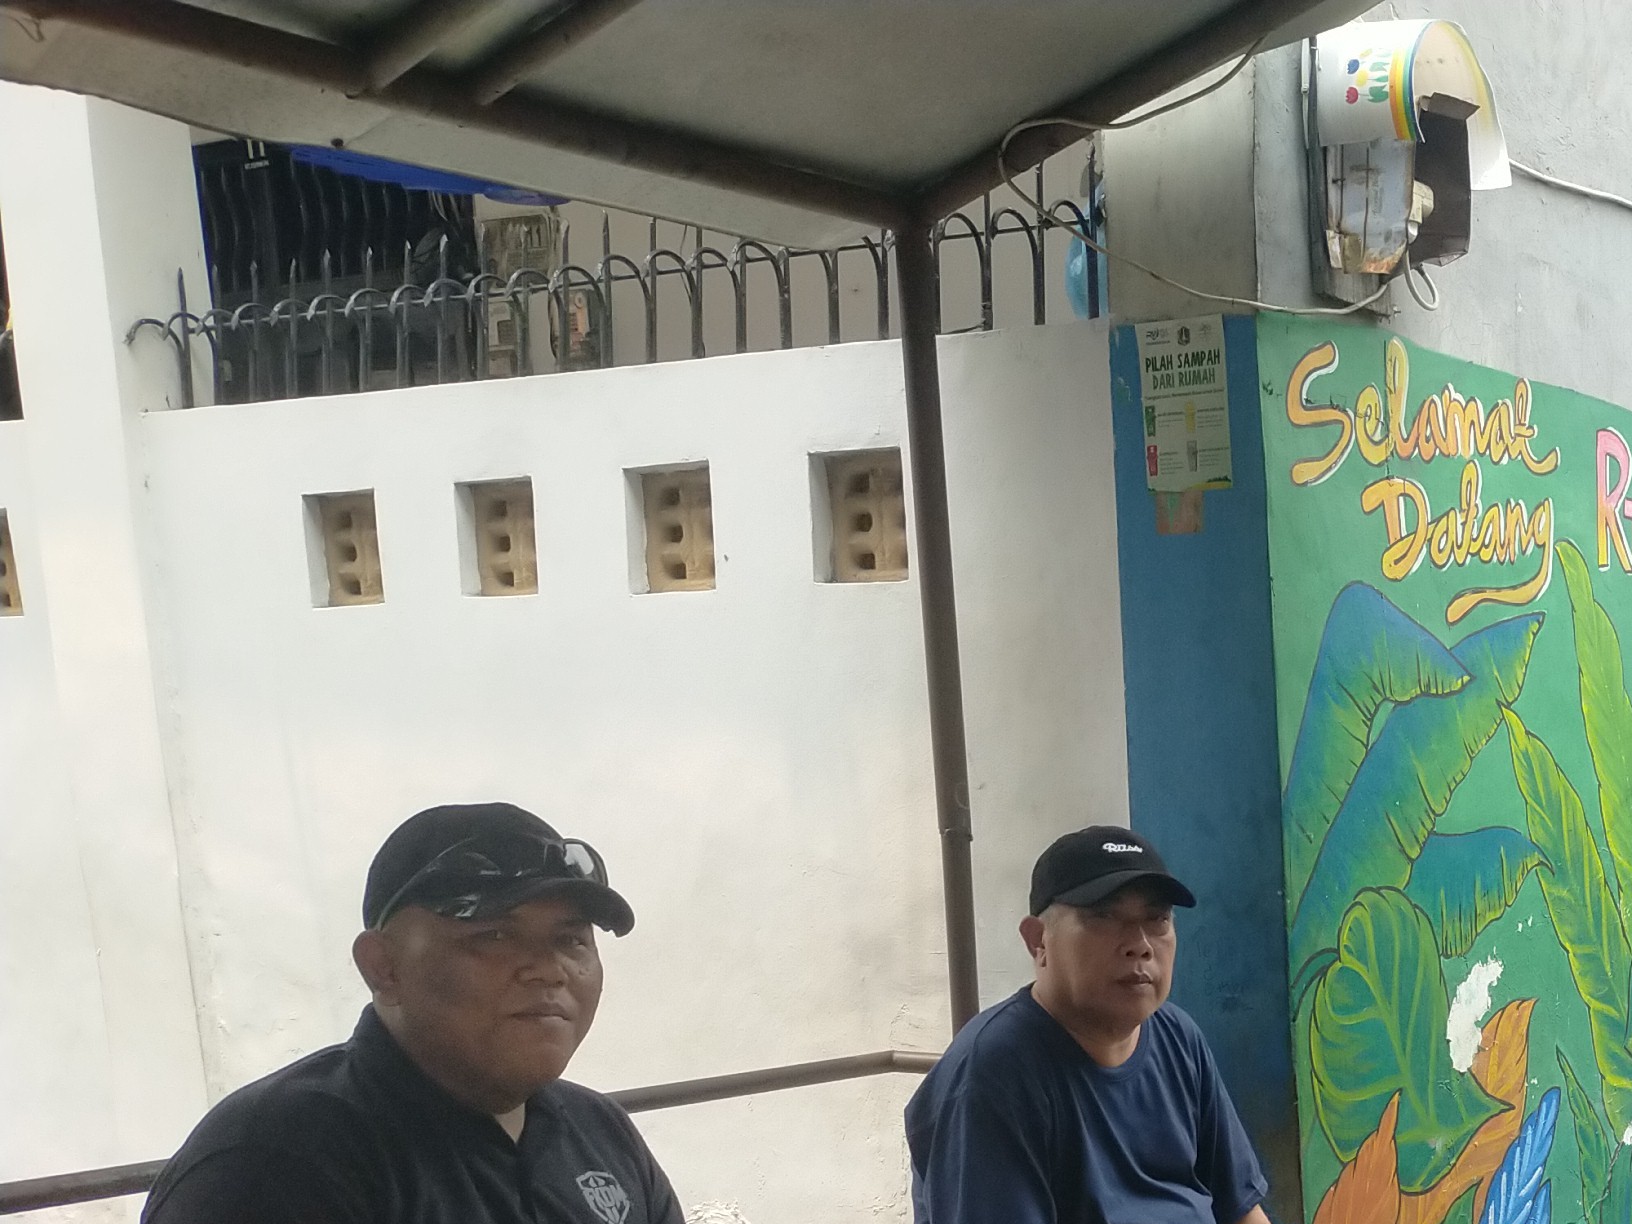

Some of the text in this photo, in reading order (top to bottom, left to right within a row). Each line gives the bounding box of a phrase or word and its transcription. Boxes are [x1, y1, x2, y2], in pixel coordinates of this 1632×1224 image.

[1145, 348, 1221, 373] PILAH SAMPAH
[1152, 368, 1216, 390] DARI RUMAH
[1286, 338, 1560, 486] Selamat
[1360, 459, 1554, 625] Datang
